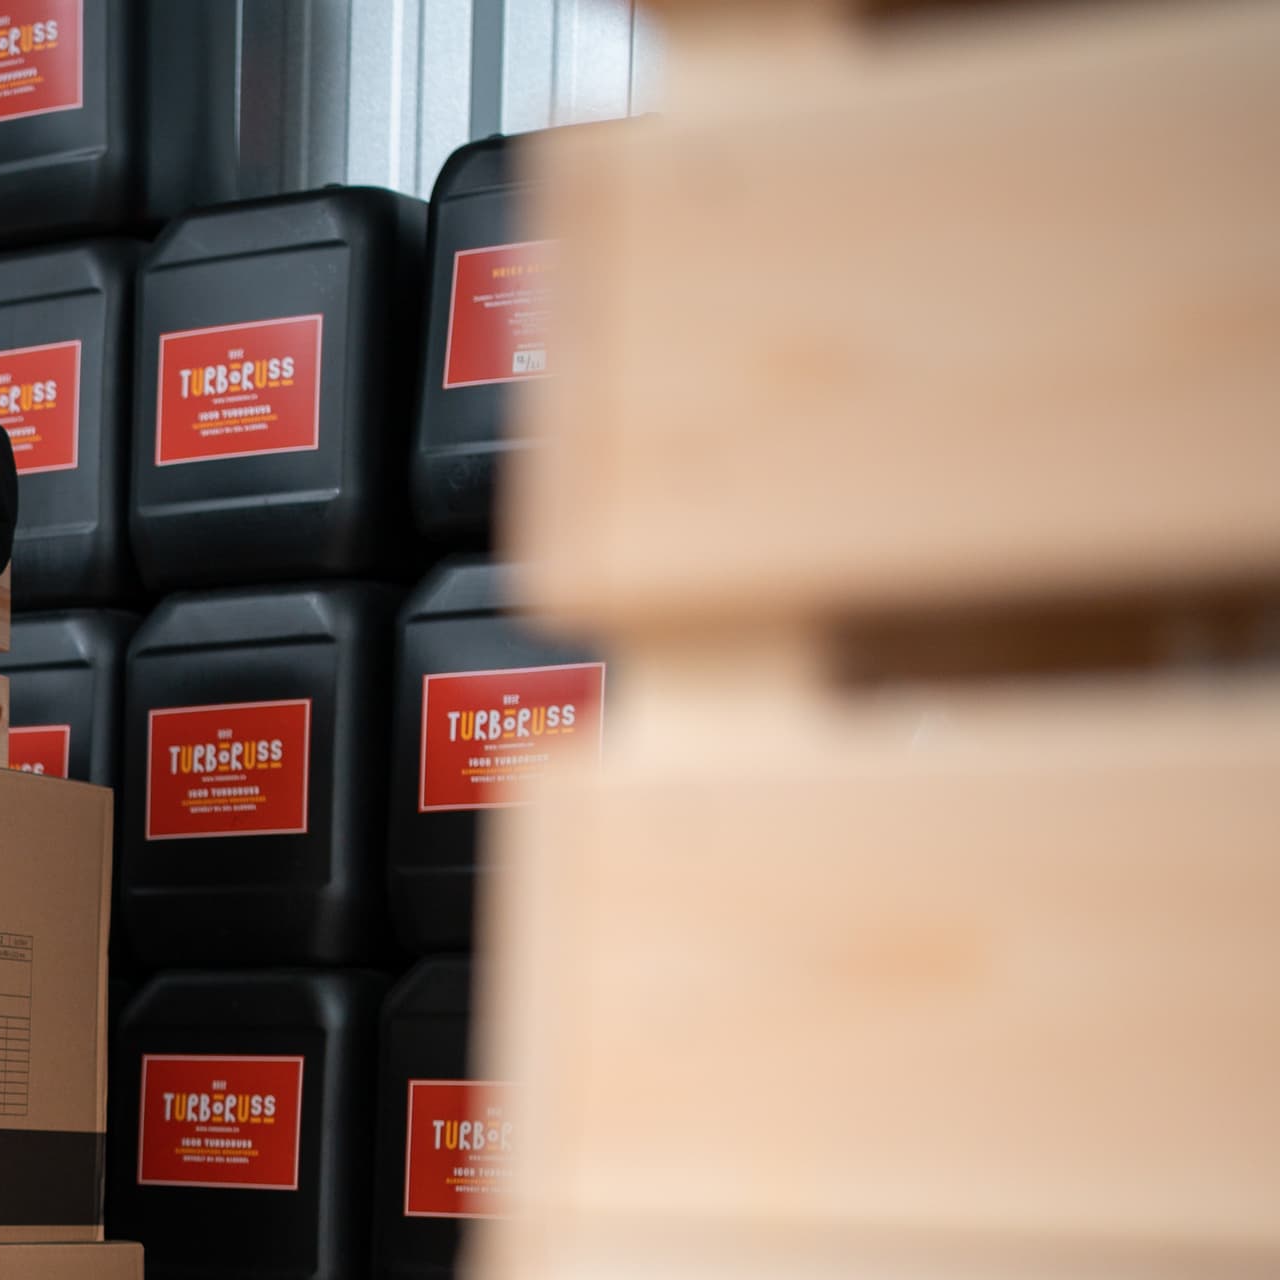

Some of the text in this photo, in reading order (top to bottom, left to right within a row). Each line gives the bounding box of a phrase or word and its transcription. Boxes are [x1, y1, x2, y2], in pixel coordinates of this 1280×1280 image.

[180, 356, 296, 399] TURBORUSS
[448, 704, 576, 742] TURBORUSS
[169, 739, 283, 775] TURBORUSS
[163, 1093, 276, 1124] TURBORUSS
